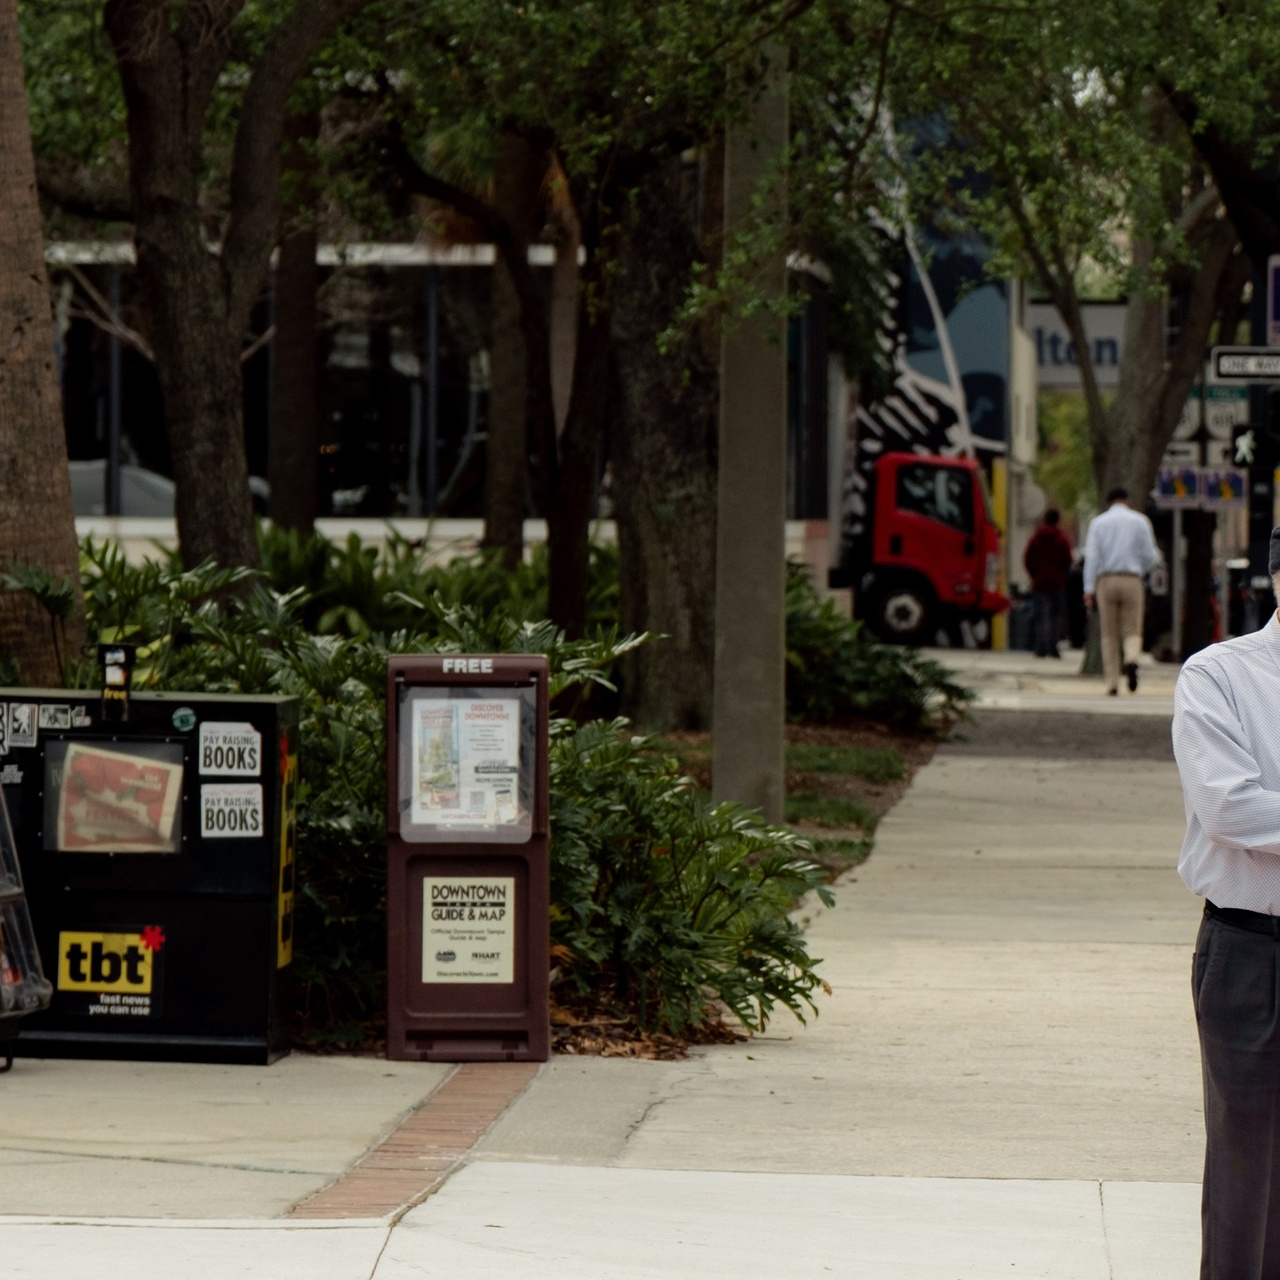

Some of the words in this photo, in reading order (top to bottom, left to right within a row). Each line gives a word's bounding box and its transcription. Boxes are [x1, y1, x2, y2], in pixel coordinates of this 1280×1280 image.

[1223, 356, 1248, 371] ONE
[1254, 356, 1280, 371] WAY
[442, 658, 493, 673] FREE
[104, 687, 127, 699] free
[470, 704, 505, 712] DISCOVER
[203, 735, 220, 745] PAY
[202, 746, 257, 769] BOOKS
[204, 797, 221, 807] PAY
[205, 808, 260, 831] BOOKS
[431, 885, 506, 900] DOWNTOWN
[431, 908, 465, 921] GUIDE
[467, 908, 476, 921] &
[478, 909, 506, 921] MAP
[66, 941, 145, 985] tbt
[99, 994, 121, 1005] fast
[122, 995, 151, 1005] news
[88, 1005, 108, 1016] you
[109, 1005, 129, 1015] can
[130, 1006, 150, 1016] use
